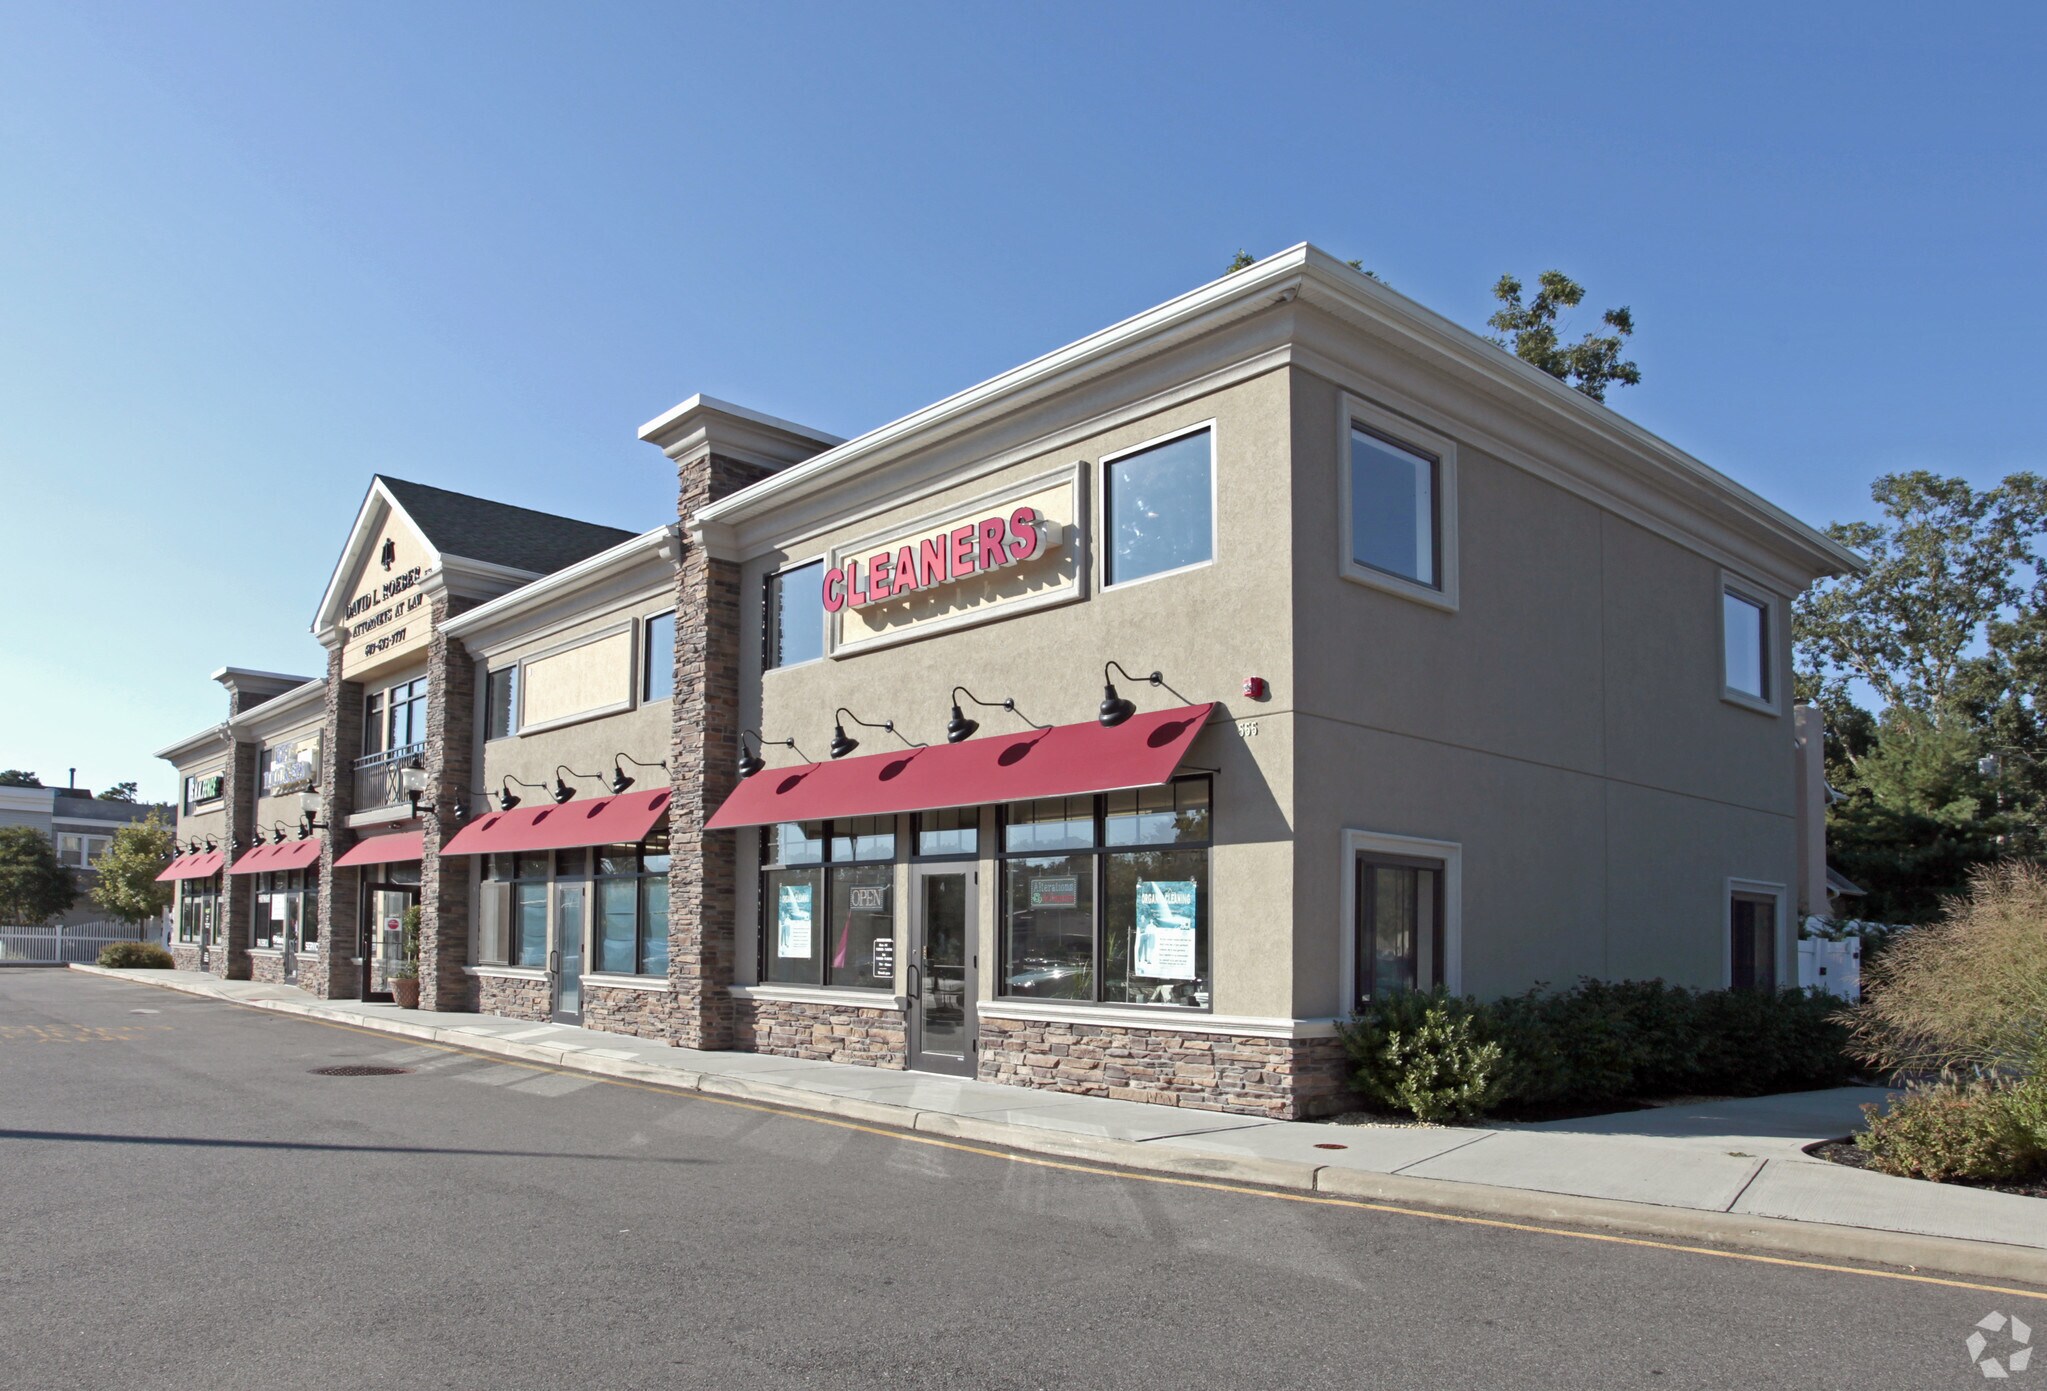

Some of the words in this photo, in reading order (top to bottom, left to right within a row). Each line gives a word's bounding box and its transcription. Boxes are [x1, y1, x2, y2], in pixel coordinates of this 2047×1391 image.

[822, 507, 1038, 613] CLEANERS
[346, 593, 371, 621] DAVID
[395, 602, 405, 618] AT
[407, 593, 423, 612] LAW
[851, 888, 881, 907] OPEN
